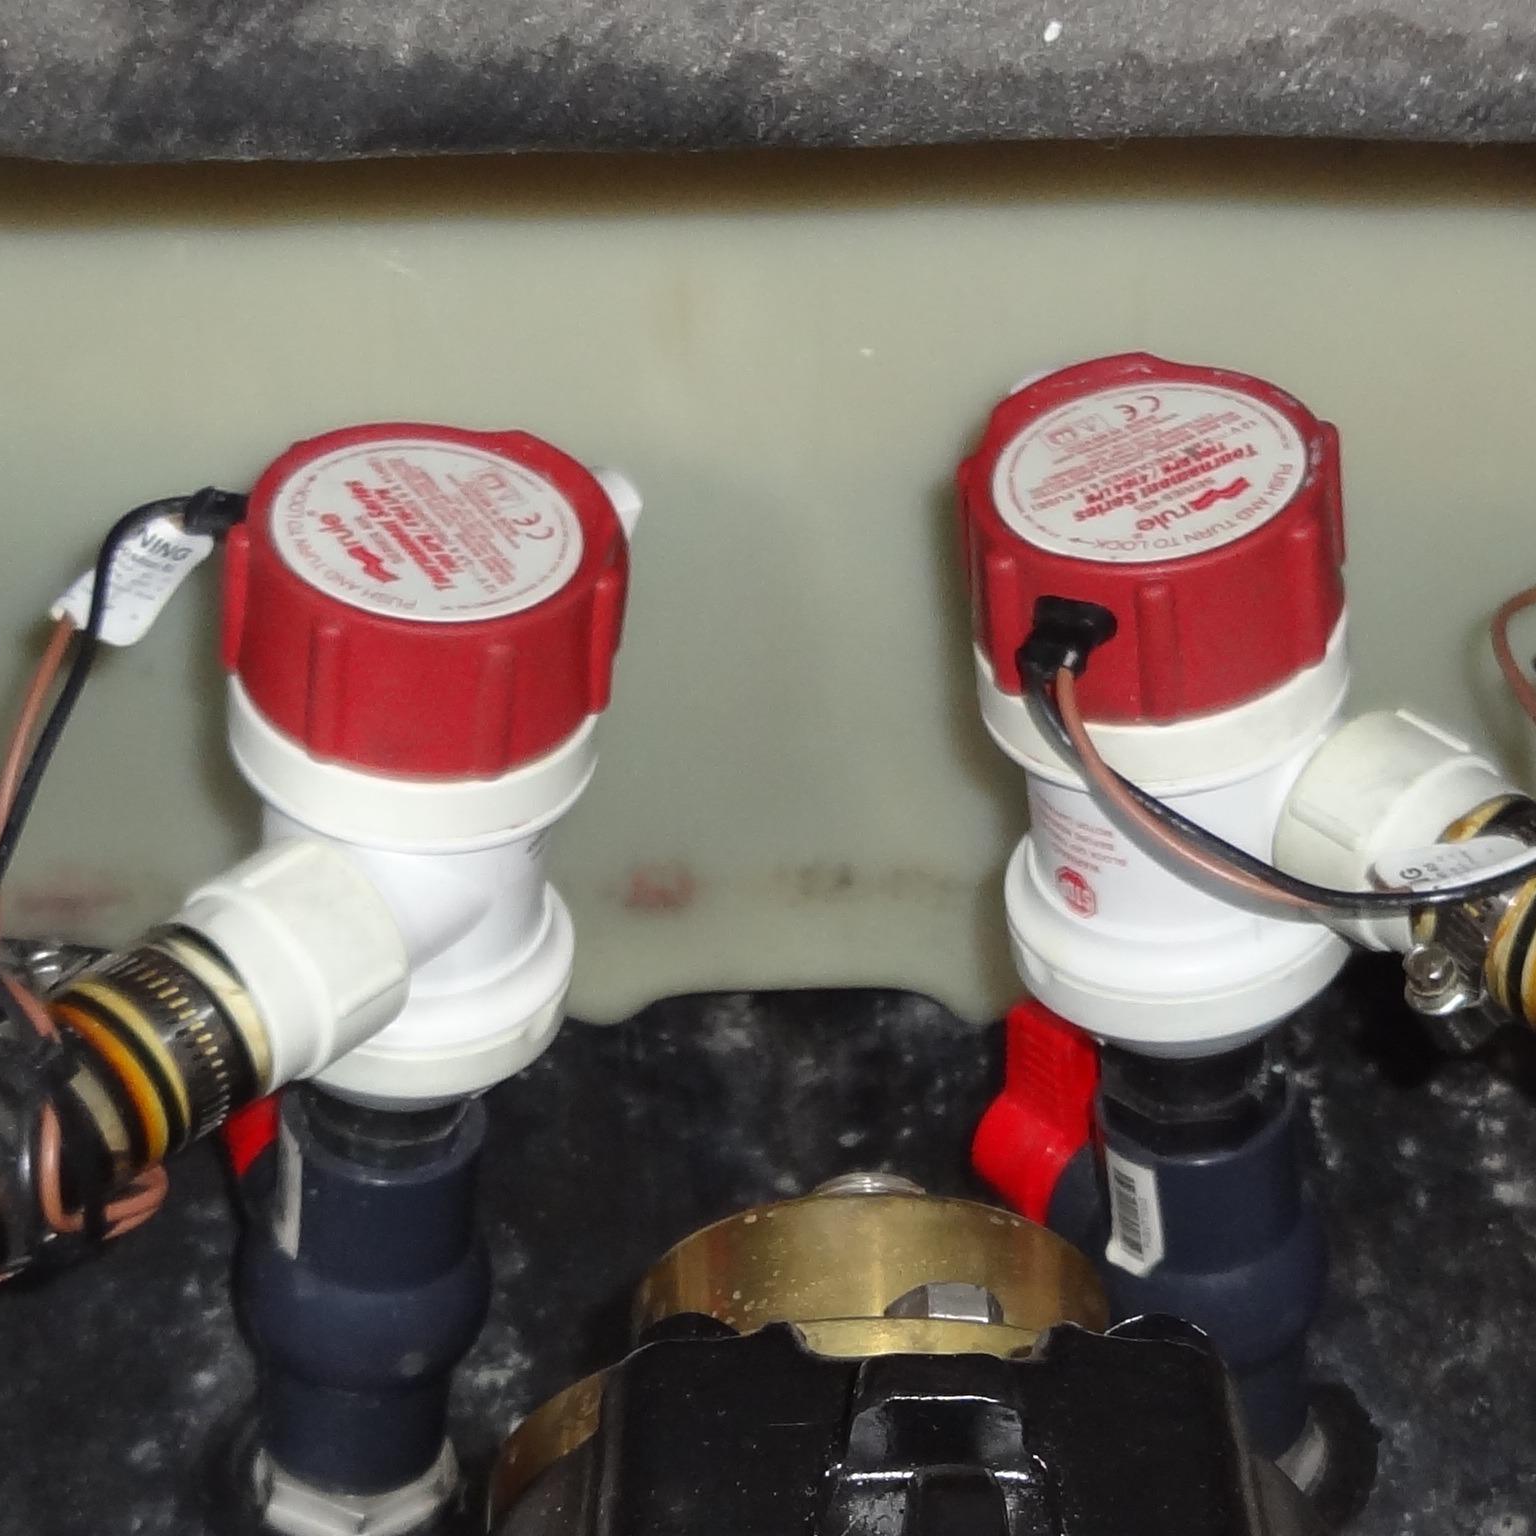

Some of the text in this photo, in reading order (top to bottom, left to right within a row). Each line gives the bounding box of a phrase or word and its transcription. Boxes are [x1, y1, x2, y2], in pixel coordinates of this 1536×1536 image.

[1265, 464, 1293, 498] PUSH
[1073, 492, 1136, 523] Series
[1134, 504, 1192, 532] rule
[1235, 498, 1266, 520] AND
[1154, 537, 1182, 550] TO
[1184, 520, 1237, 544] TURN
